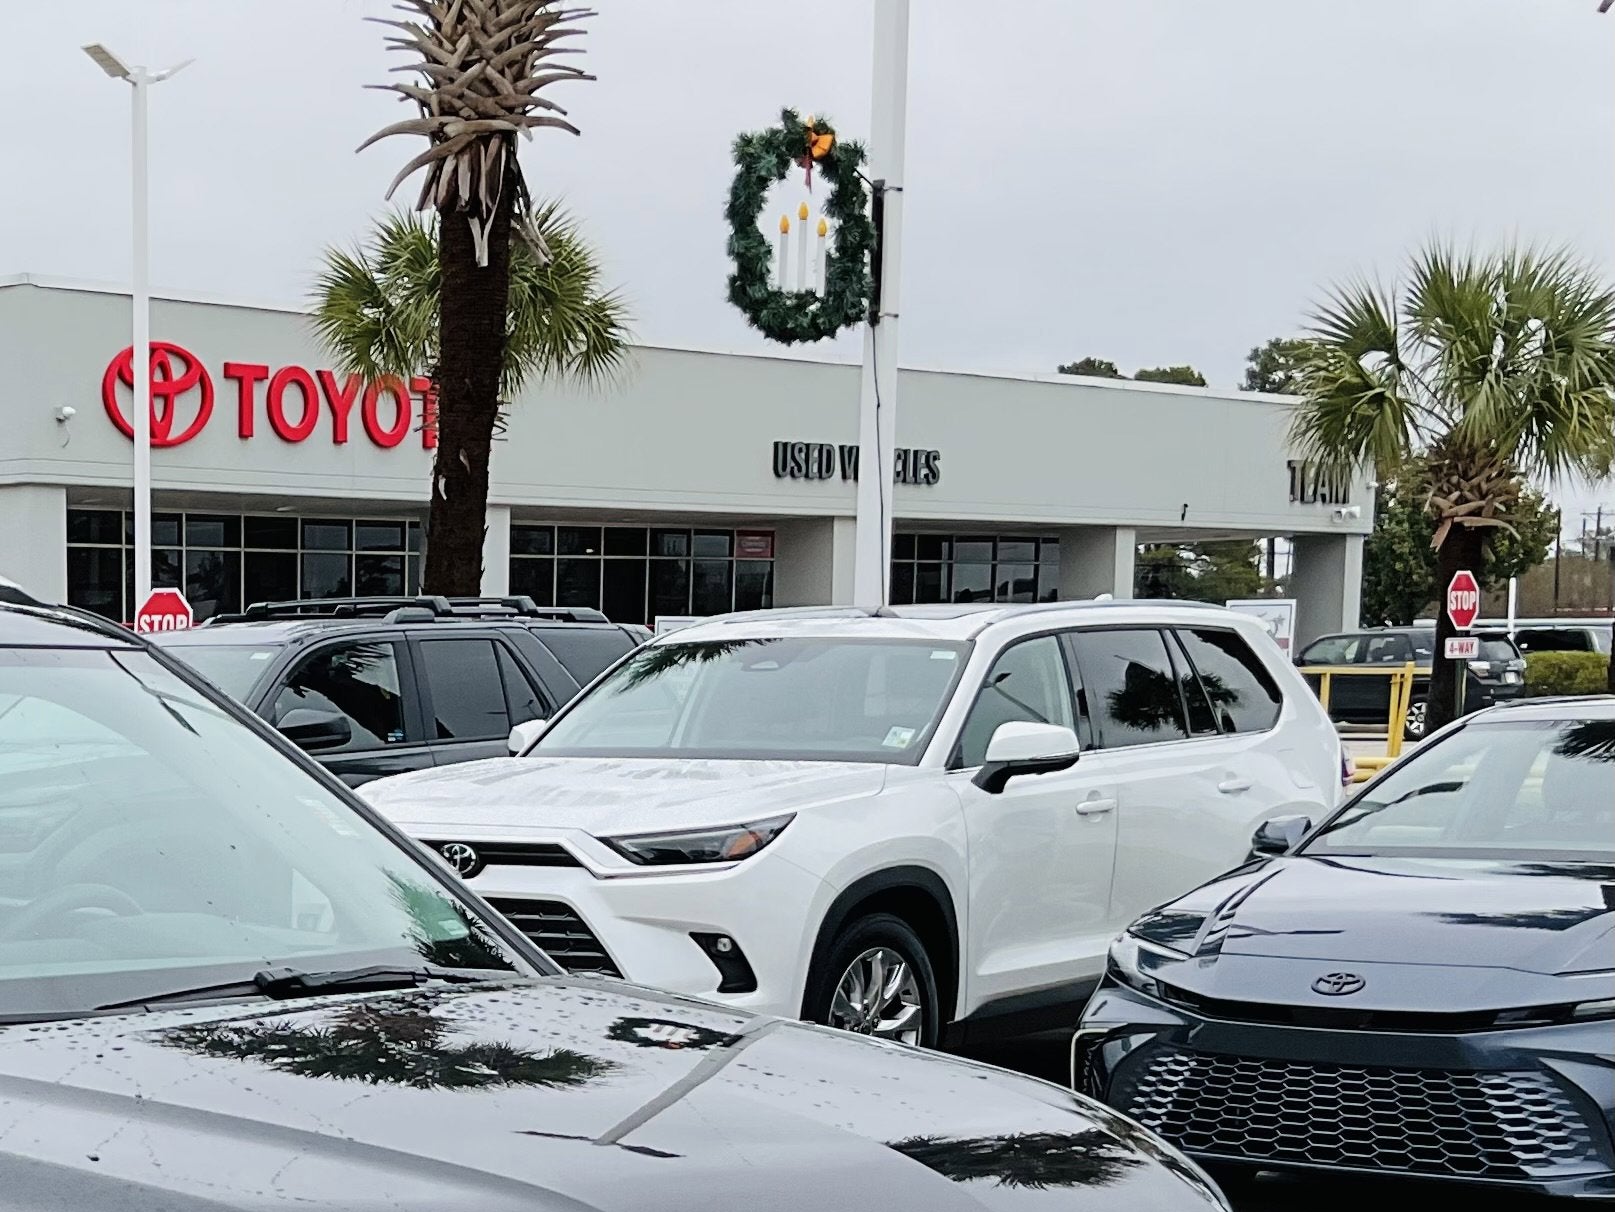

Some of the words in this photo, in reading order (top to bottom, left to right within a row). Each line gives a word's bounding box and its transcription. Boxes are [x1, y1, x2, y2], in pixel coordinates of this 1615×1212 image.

[223, 361, 441, 450] TOYOT
[773, 441, 835, 479] USED
[1450, 590, 1476, 611] STOP
[1449, 641, 1475, 654] 4-WAY
